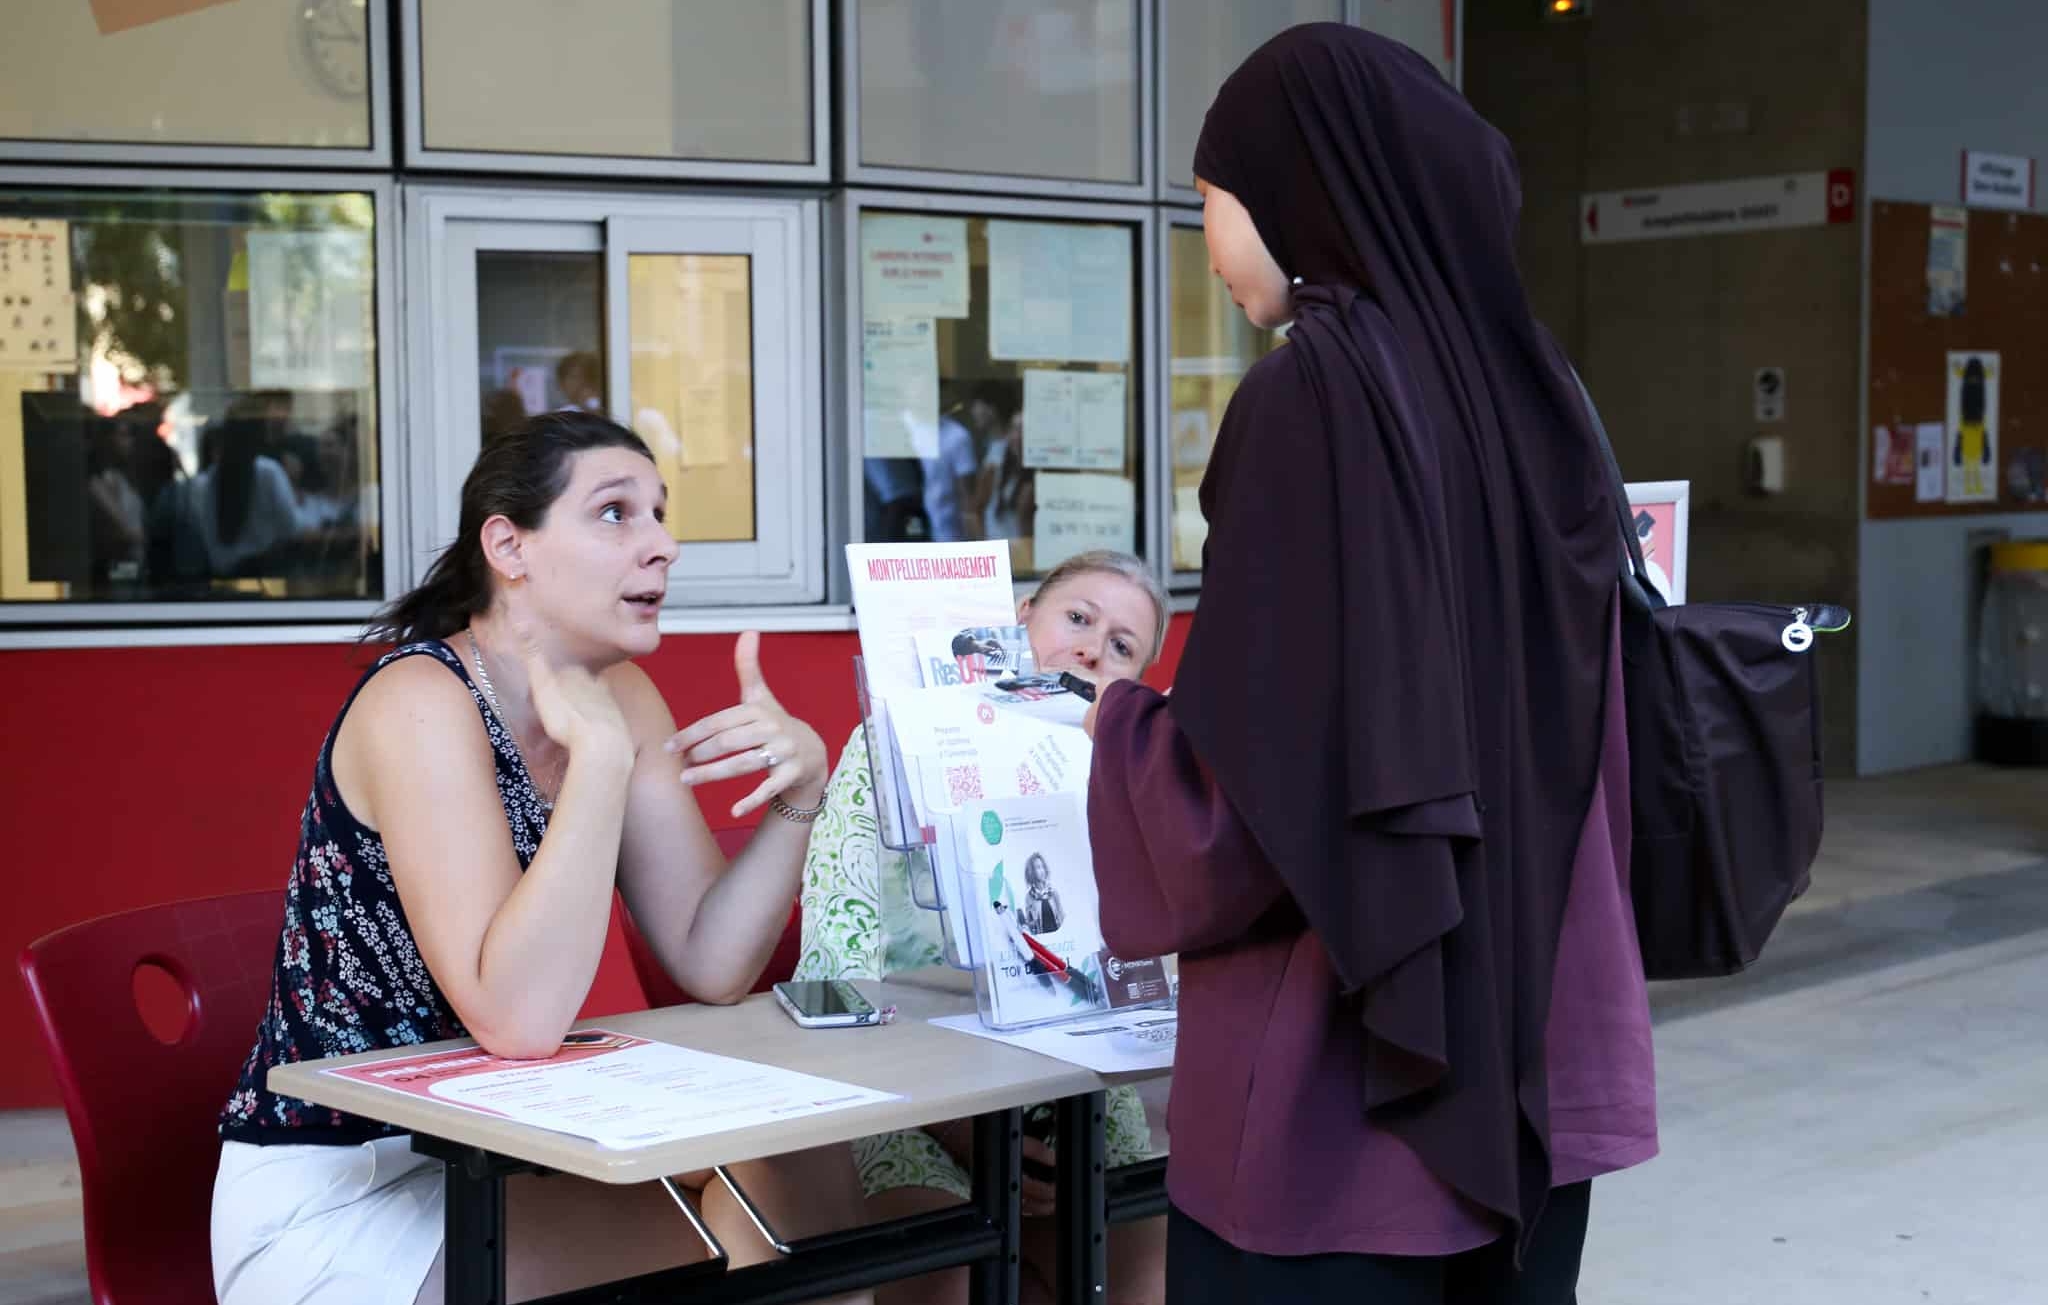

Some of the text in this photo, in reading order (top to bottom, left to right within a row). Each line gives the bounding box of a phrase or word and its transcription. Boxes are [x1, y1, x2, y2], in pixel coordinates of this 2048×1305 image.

[1831, 184, 1849, 208] D
[867, 555, 997, 581] MONTPELLIER MANAGEMENT
